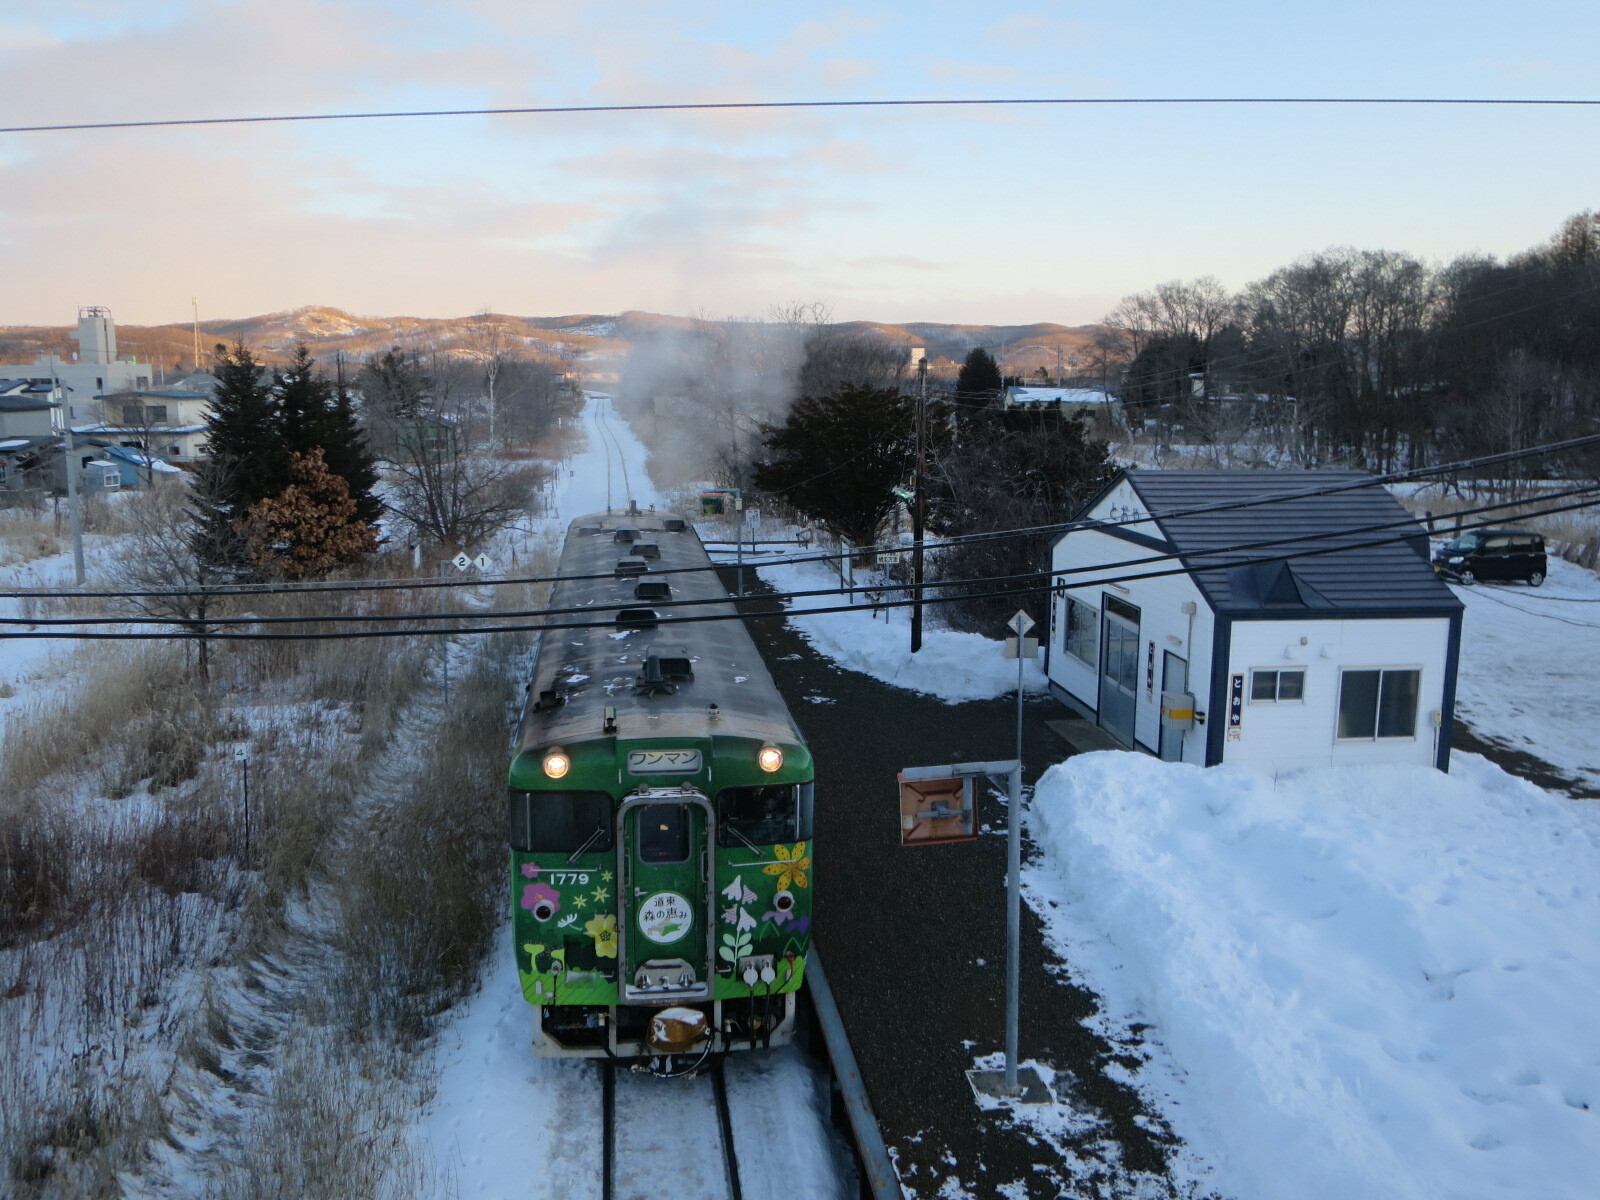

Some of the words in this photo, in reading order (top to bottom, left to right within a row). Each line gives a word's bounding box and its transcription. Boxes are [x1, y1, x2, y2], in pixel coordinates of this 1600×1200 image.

[459, 557, 465, 566] 2
[480, 558, 485, 567] 1
[1231, 678, 1241, 723] とおや
[629, 753, 698, 766] ワンマン
[550, 873, 589, 885] 1779
[653, 895, 677, 908] 道東
[643, 907, 688, 923] 森の恵み
